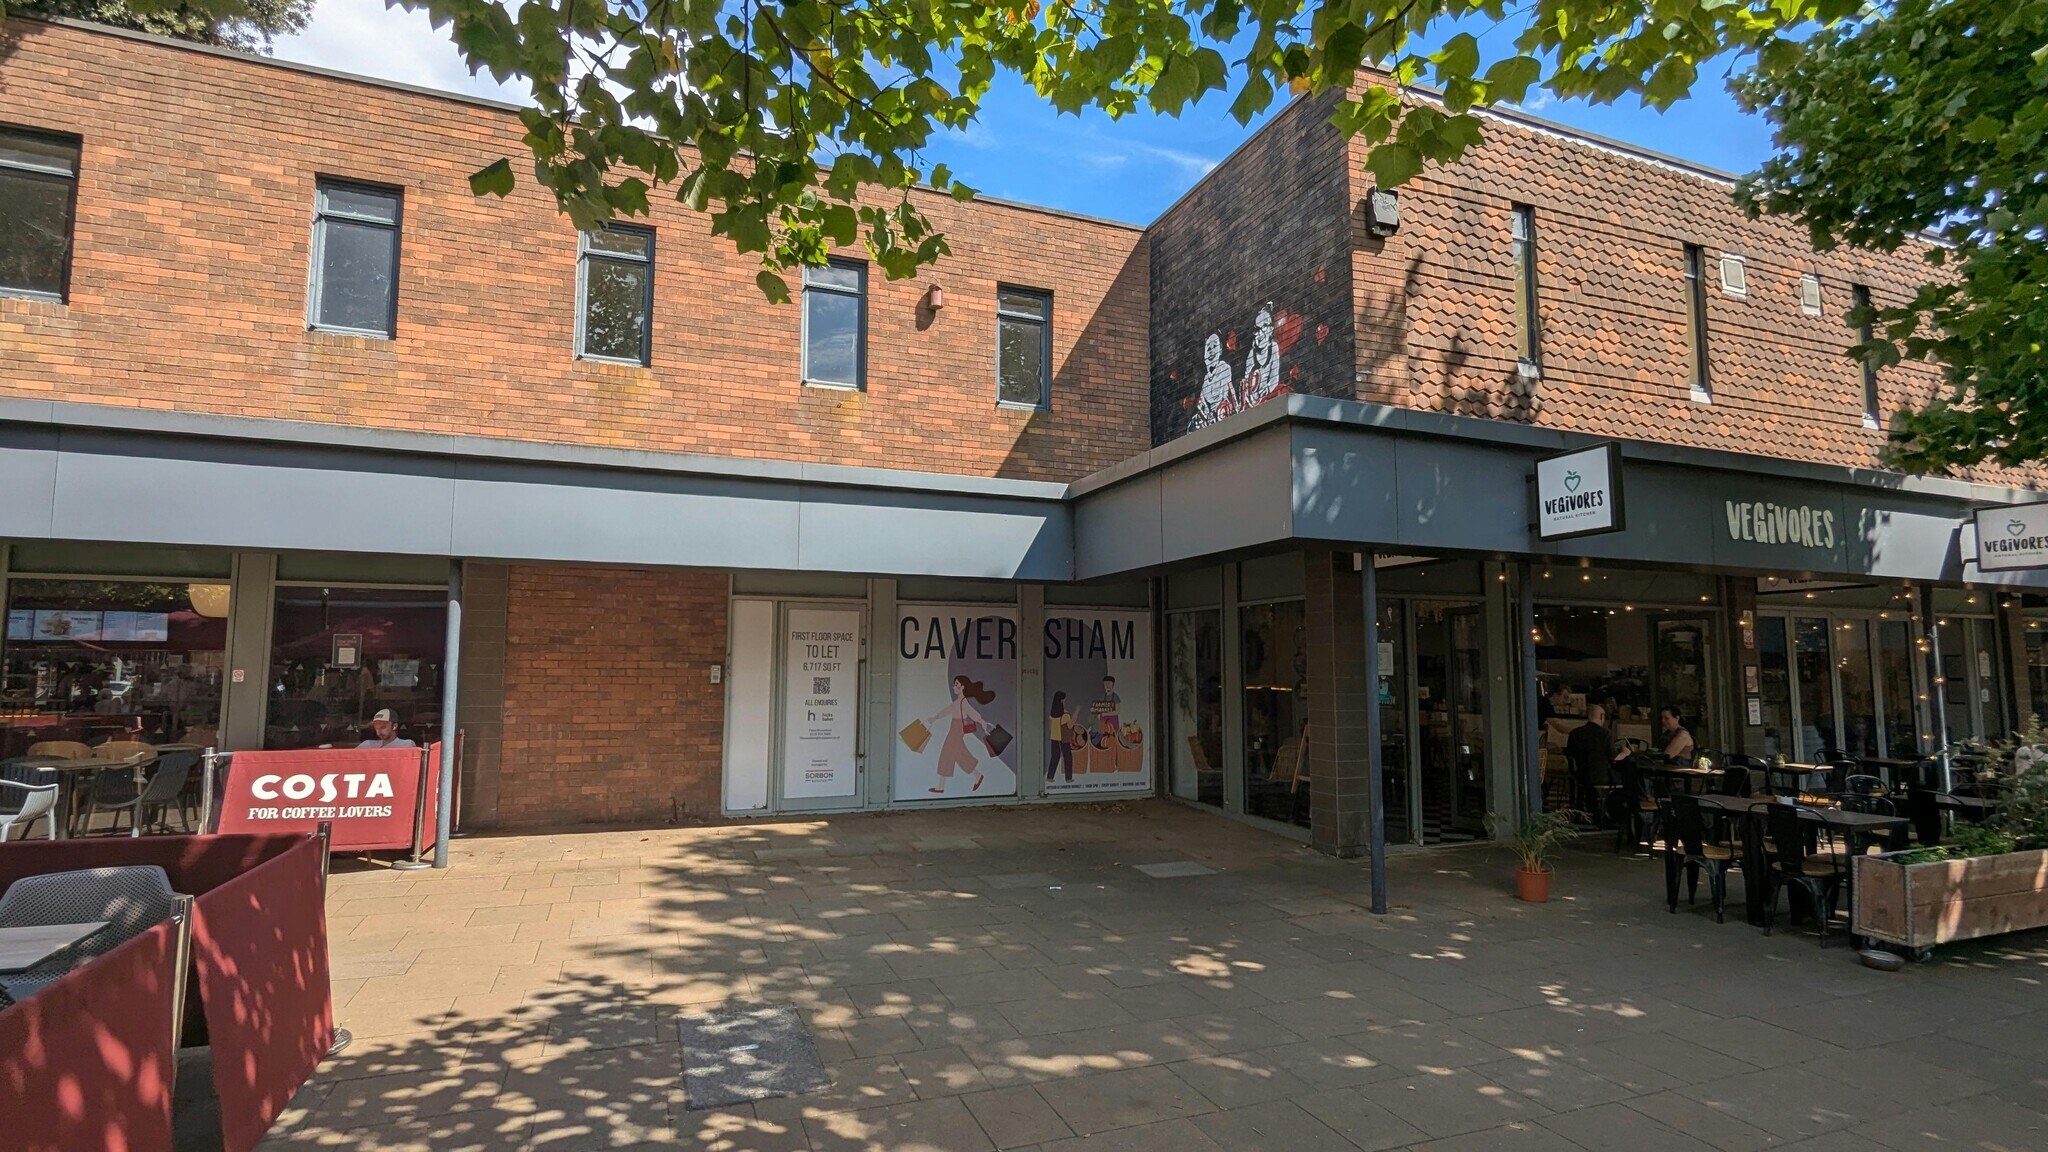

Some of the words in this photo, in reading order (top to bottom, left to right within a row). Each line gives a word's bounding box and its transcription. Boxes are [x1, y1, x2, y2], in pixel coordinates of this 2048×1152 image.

[791, 631, 810, 641] FIRST
[812, 632, 831, 641] FLOOR
[833, 632, 853, 642] SPACE
[900, 616, 1017, 660] CAVER
[1044, 618, 1134, 660] SHAM
[806, 645, 819, 658] TO
[821, 645, 839, 658] LET
[803, 662, 821, 672] 6,717
[823, 663, 831, 671] SQ
[833, 663, 841, 671] FT
[807, 710, 816, 721] h
[252, 773, 394, 802] COSTA
[247, 807, 279, 819] FOR
[282, 806, 336, 819] COFFEE
[338, 805, 392, 818] LOVERS
